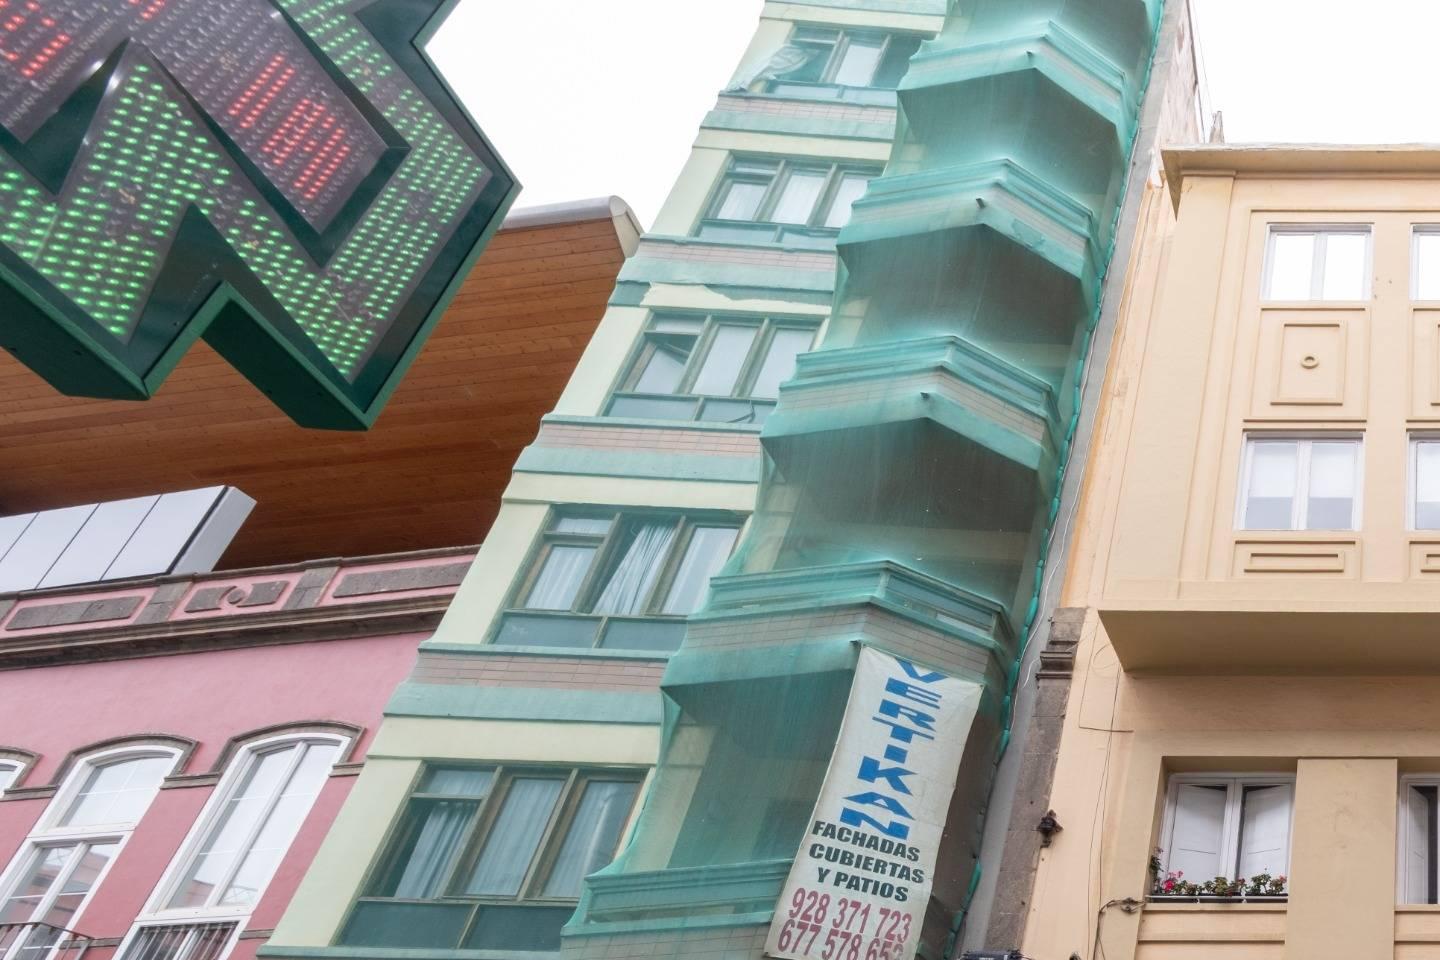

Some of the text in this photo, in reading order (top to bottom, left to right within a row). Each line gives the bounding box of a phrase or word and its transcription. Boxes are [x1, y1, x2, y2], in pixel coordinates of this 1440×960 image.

[812, 820, 921, 862] FACHADAS
[809, 843, 925, 884] CUBIERTAS
[817, 867, 909, 902] Y PATIOS
[789, 887, 912, 944] 928 371 723
[778, 919, 822, 956] 677
